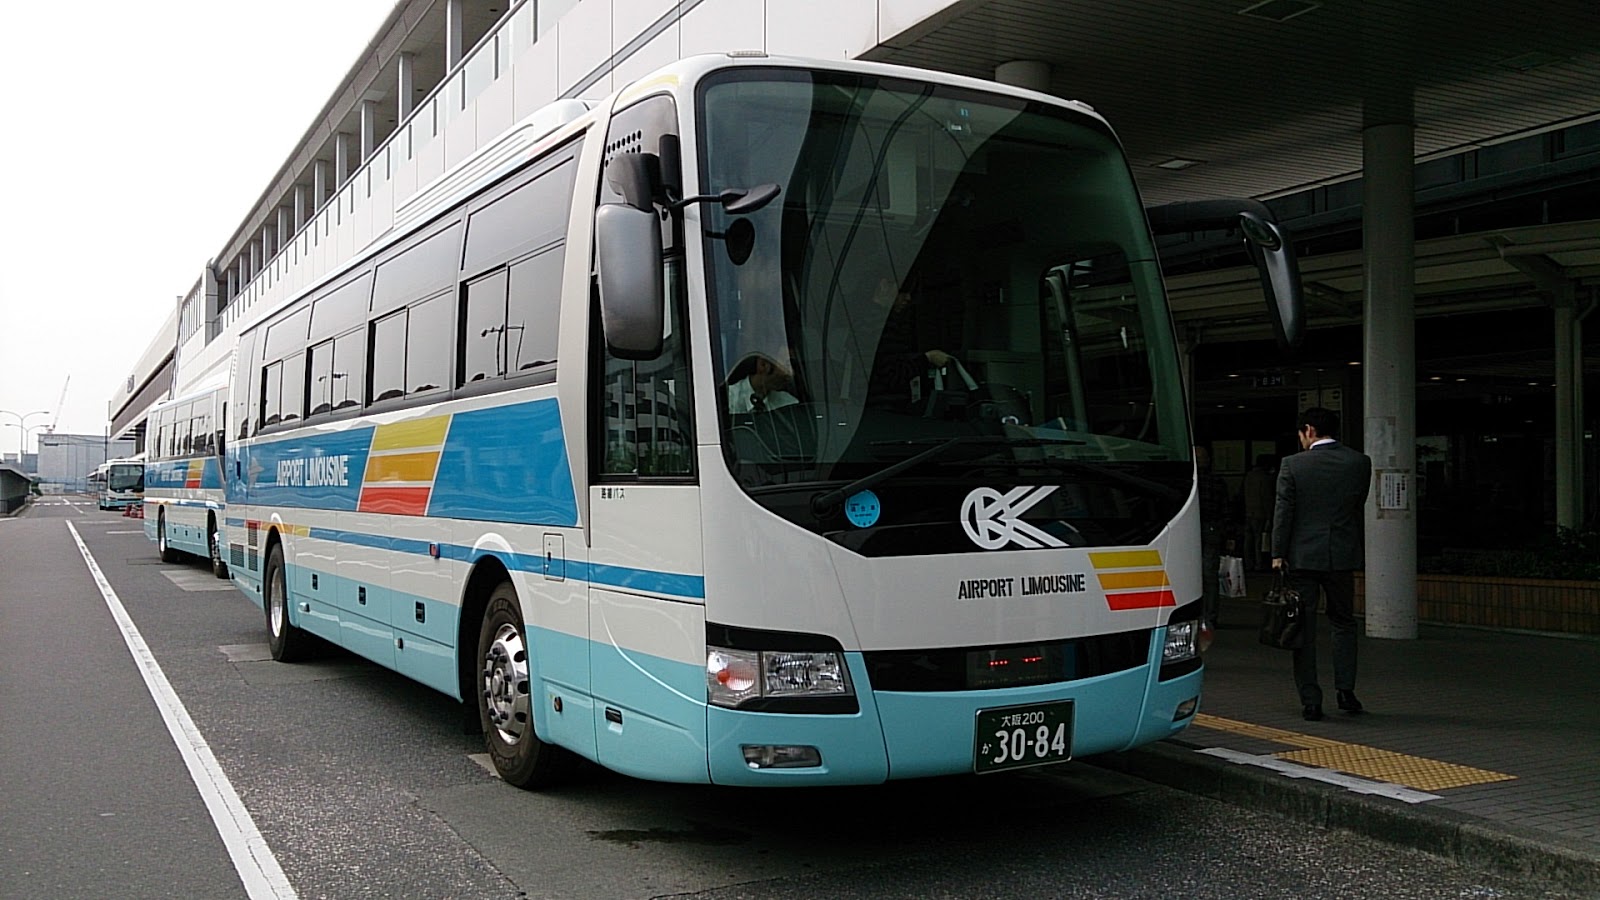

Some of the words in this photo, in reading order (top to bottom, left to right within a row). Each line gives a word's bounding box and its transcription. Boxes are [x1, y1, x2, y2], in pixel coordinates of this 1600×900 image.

[276, 458, 304, 487] AIRPORT
[304, 455, 349, 487] LIMOUSINE
[957, 577, 1014, 600] AIRPORT
[1021, 573, 1086, 596] LIMOUSINE
[981, 742, 992, 755] か
[993, 722, 1065, 764] 30-84
